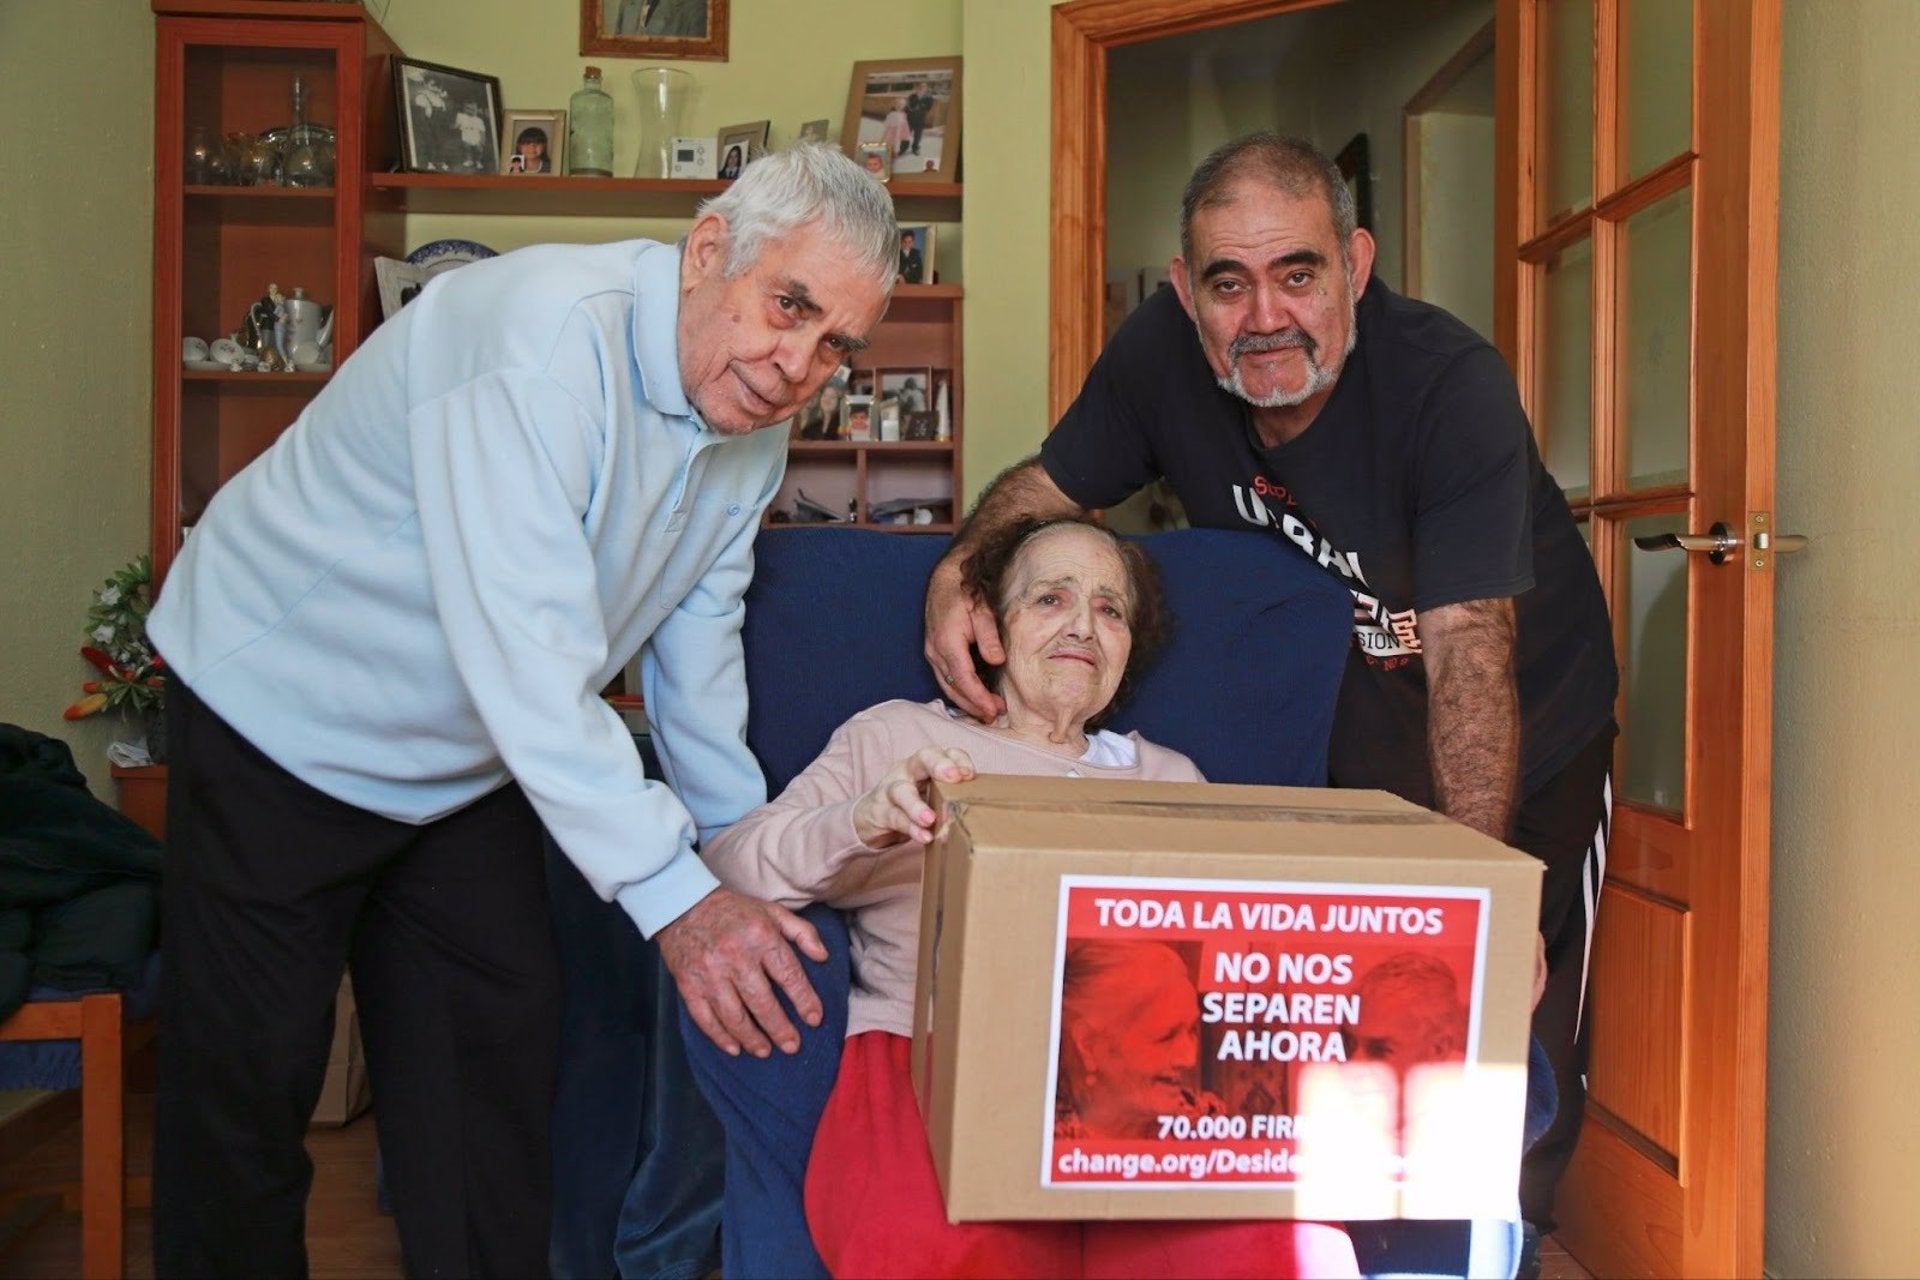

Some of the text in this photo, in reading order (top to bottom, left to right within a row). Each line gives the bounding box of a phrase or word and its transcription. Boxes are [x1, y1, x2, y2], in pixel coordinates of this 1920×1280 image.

[1094, 898, 1444, 935] TODA LA VIDA JUNTOS
[1214, 952, 1354, 985] NO NOS
[1202, 992, 1361, 1025] SEPAREN
[1217, 1029, 1347, 1062] AHORA
[1157, 1115, 1247, 1140] 70.000
